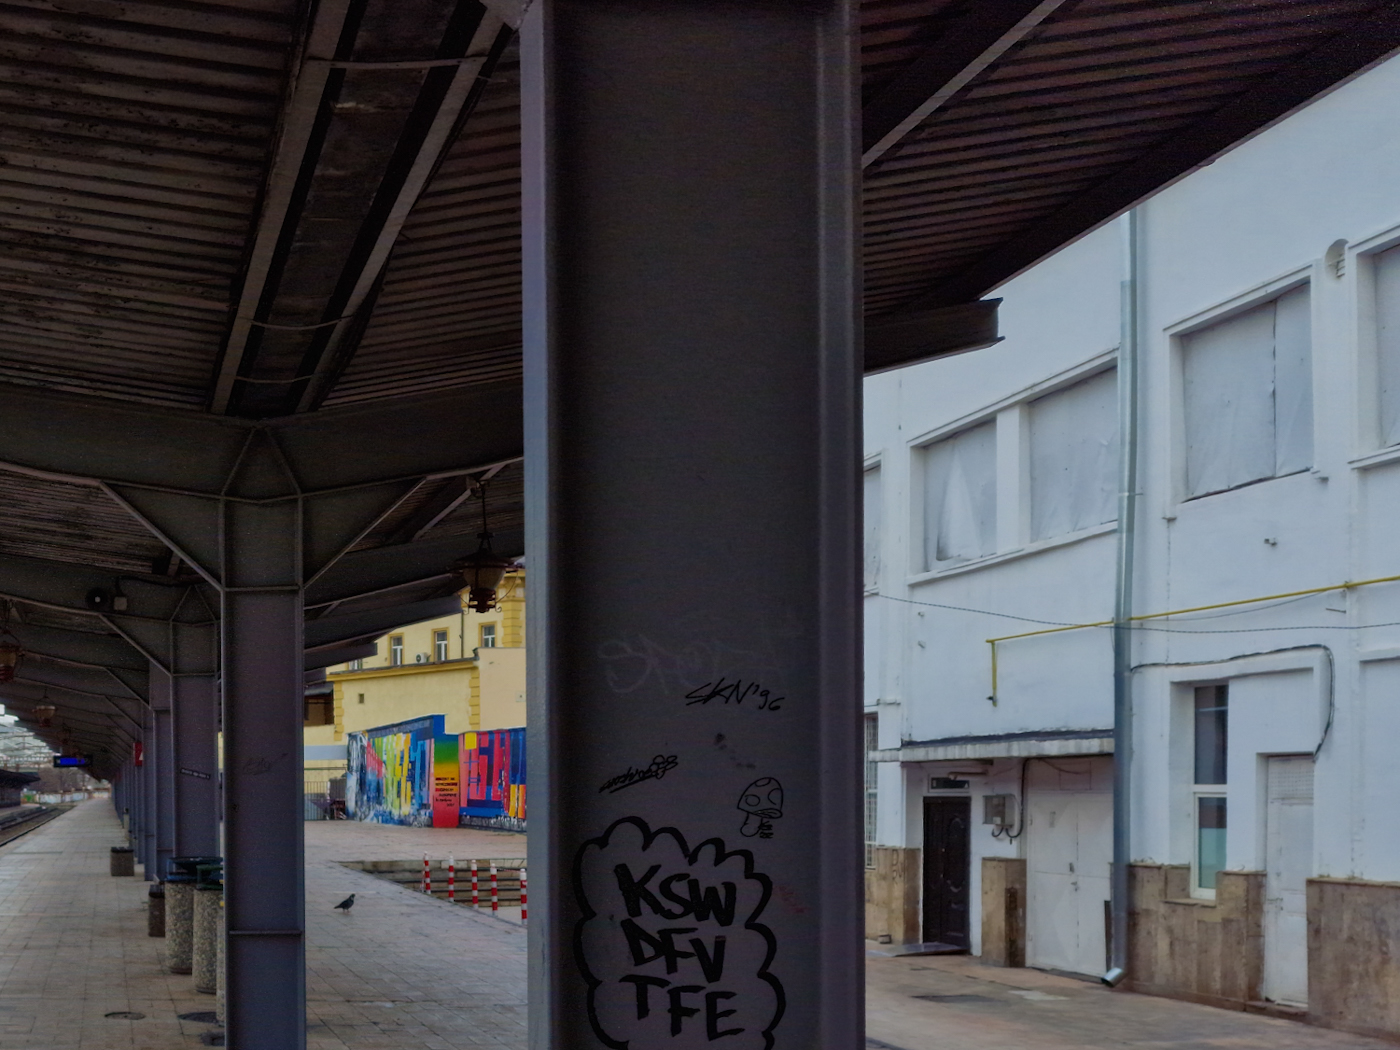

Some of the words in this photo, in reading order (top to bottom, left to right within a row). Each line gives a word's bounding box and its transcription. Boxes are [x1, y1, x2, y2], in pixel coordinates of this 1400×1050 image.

[614, 863, 737, 927] KSW
[620, 918, 726, 983] DFV
[618, 974, 746, 1042] TFE
